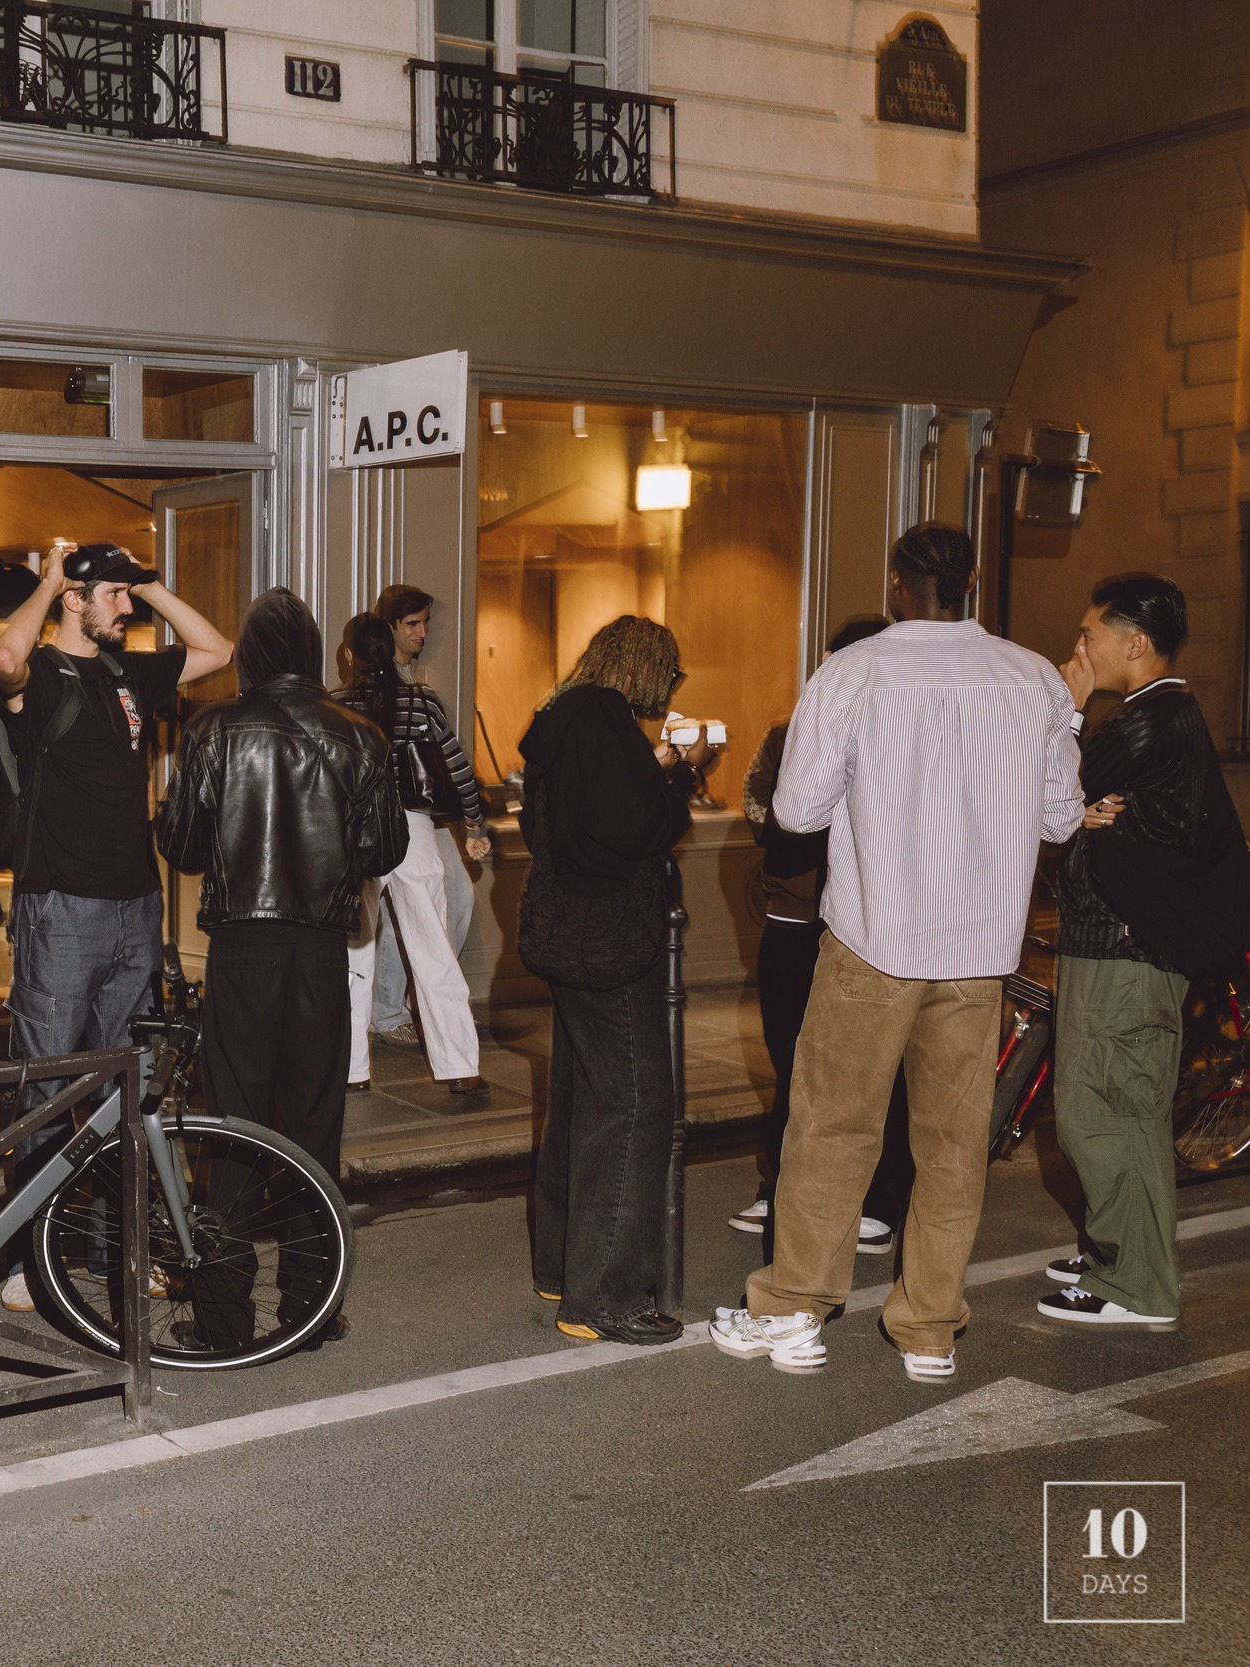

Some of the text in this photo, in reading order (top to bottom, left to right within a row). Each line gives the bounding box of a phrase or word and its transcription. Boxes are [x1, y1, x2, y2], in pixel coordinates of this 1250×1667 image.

[293, 60, 334, 97] 112
[908, 60, 935, 77] RUE
[895, 77, 948, 98] VIEILLE
[885, 94, 957, 117] DU TEMPLE
[352, 404, 449, 455] A.P.C.
[69, 1134, 94, 1159] ELOPS
